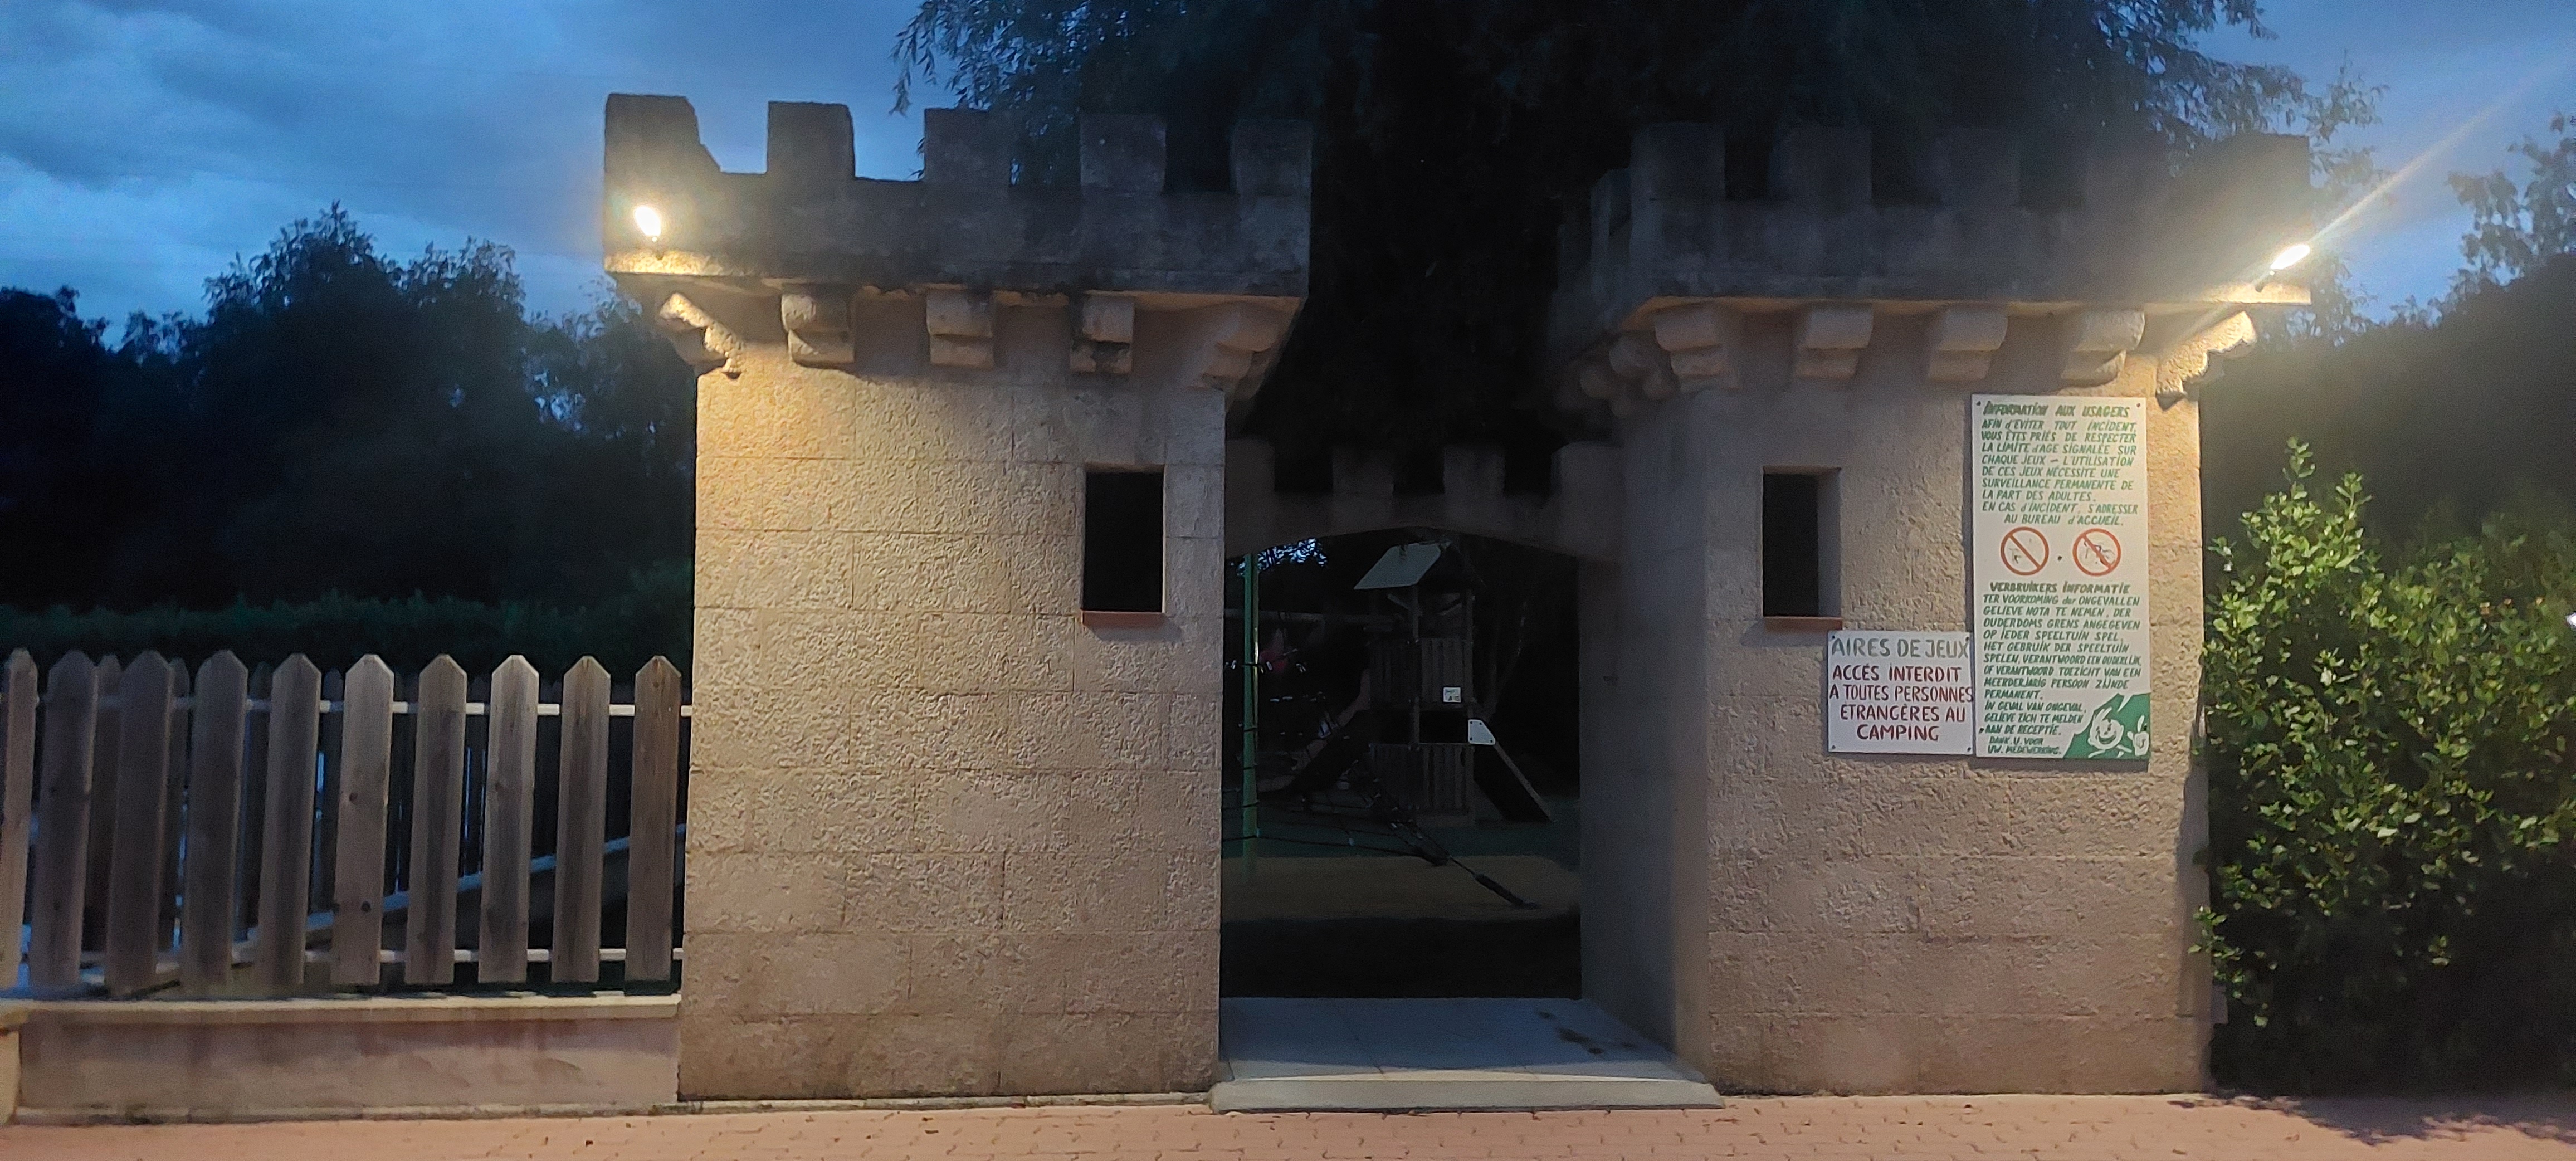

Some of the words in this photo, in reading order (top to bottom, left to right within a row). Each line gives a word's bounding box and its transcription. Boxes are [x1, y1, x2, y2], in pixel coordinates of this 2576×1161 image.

[2055, 405, 2076, 416] AUX
[2082, 405, 2130, 418] USAGERS
[2054, 421, 2077, 431] TOUT
[1982, 431, 2002, 441] VOUS
[2065, 432, 2077, 441] DE
[2085, 432, 2136, 443] RESPECTER
[1982, 443, 1995, 452] LA
[1997, 442, 2029, 453] LIMITE
[2118, 445, 2136, 455] SUR
[1982, 454, 2018, 464] CHAQUE
[2021, 454, 2046, 465] JEUX
[1982, 466, 1995, 476] DE
[1998, 467, 2015, 476] CES
[2019, 466, 2043, 476] JEUX
[2100, 468, 2120, 478] UNE
[1982, 478, 2051, 489] SURVEILLANCE
[2053, 479, 2116, 490] PERMANENTE
[2121, 481, 2134, 490] DE
[1982, 490, 1995, 499] LA
[1996, 490, 2022, 500] PART
[2026, 491, 2043, 500] DES
[1982, 502, 1996, 511] EN
[1998, 502, 2016, 511] CAS
[2004, 514, 2017, 523] AU
[2022, 514, 2061, 524] BUREAU
[2062, 581, 2131, 594] INFORMATIE
[1983, 594, 1999, 603] TER
[2078, 596, 2140, 606] ONGEVALLEN
[1983, 606, 2024, 616] GELIEVE
[2026, 607, 2050, 616] NOTA
[2056, 608, 2066, 616] TE
[2113, 608, 2131, 617] DER
[1983, 618, 2042, 628] OUDERDOMS
[2047, 619, 2079, 628] GRENS
[2083, 621, 2140, 630] ANGEGEVEN
[1983, 630, 1996, 640] OP
[2001, 628, 2030, 640] IEDER
[2035, 630, 2089, 641] SPEELTUIN
[1832, 638, 1890, 657] AIRES
[1897, 638, 1920, 657] DE
[1925, 639, 1969, 658] JEUX
[1984, 642, 2004, 651] HET
[2007, 642, 2051, 652] GEBRUIK
[2054, 642, 2072, 652] DER
[2077, 643, 2129, 653] SPEELTUIN
[1889, 663, 1962, 682] INTERDIT
[1984, 666, 1996, 675] OF
[2059, 666, 2101, 676] TOEZICHT
[2104, 667, 2122, 676] VAN
[2123, 668, 2141, 677] EEN
[2051, 679, 2089, 689] PERSOON
[1829, 684, 1839, 699] A
[1843, 684, 1889, 701] TOUTES
[1895, 686, 1974, 703] PERSONNES
[1985, 701, 1995, 710] IN
[1998, 702, 2023, 711] GEVAL
[2027, 702, 2044, 711] VAN
[1945, 707, 1965, 722] AU
[1984, 714, 2016, 723] GELIEVE
[2018, 714, 2037, 723] ZICH
[2052, 715, 2083, 724] MELDEN
[1857, 724, 1940, 741] CAMPING
[1985, 725, 2002, 733] AAN
[2004, 725, 2016, 734] DE
